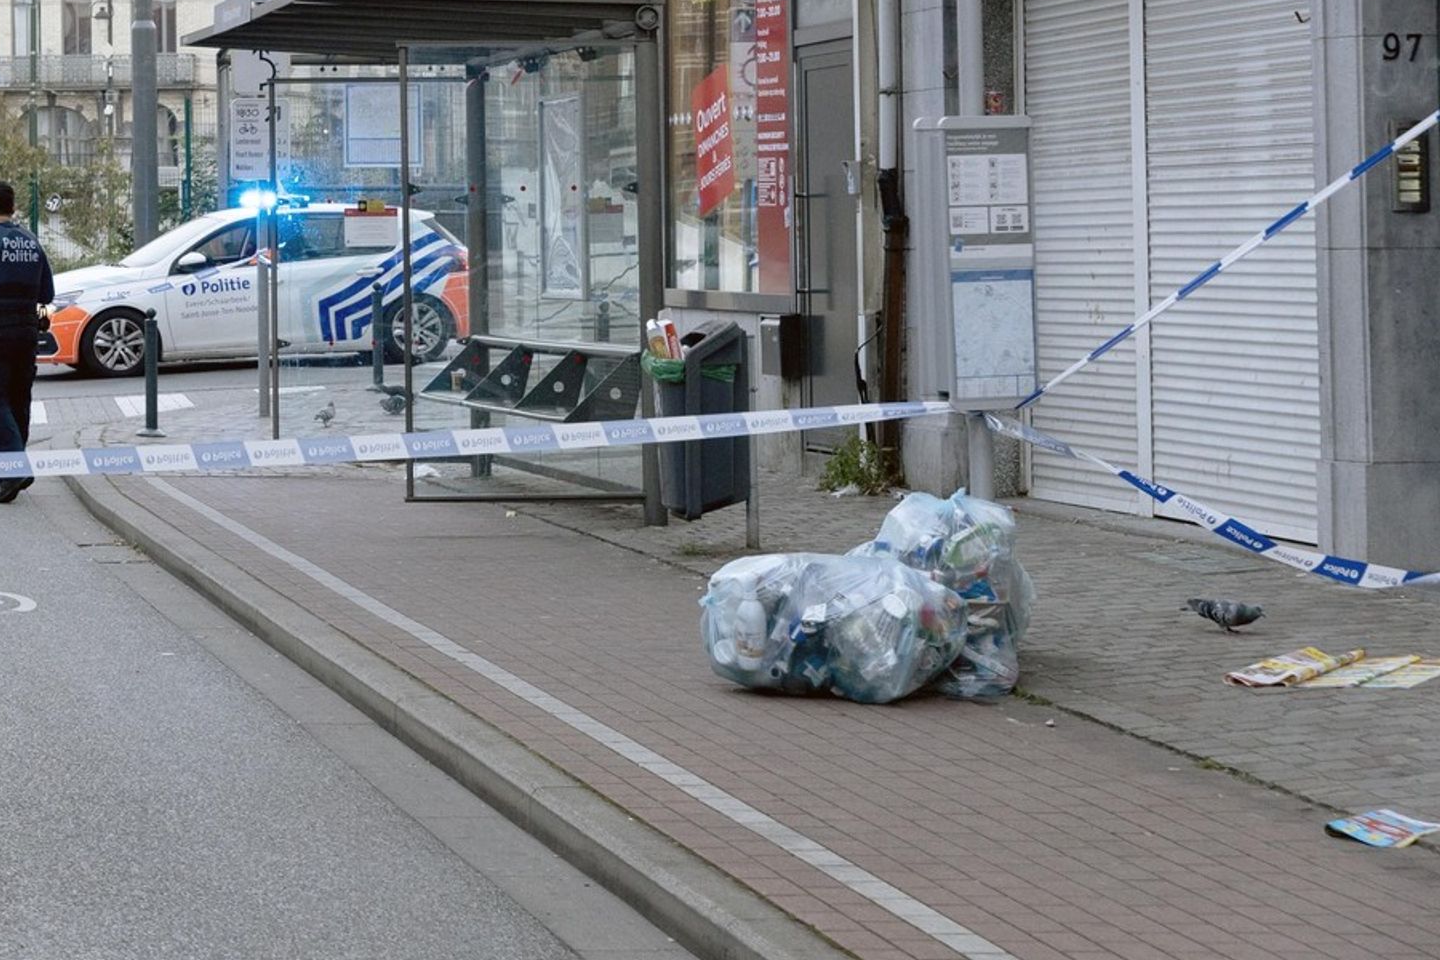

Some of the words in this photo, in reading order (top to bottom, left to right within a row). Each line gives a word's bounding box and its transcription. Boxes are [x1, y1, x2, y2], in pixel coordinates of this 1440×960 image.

[1383, 32, 1423, 62] 97
[697, 92, 727, 133] Ouvert
[2, 236, 37, 249] Police
[1, 250, 40, 262] Politie
[201, 277, 251, 294] Politie
[1176, 497, 1206, 520] Politie
[1225, 525, 1255, 547] Police
[1272, 549, 1304, 565] Politie
[1322, 563, 1349, 578] Police
